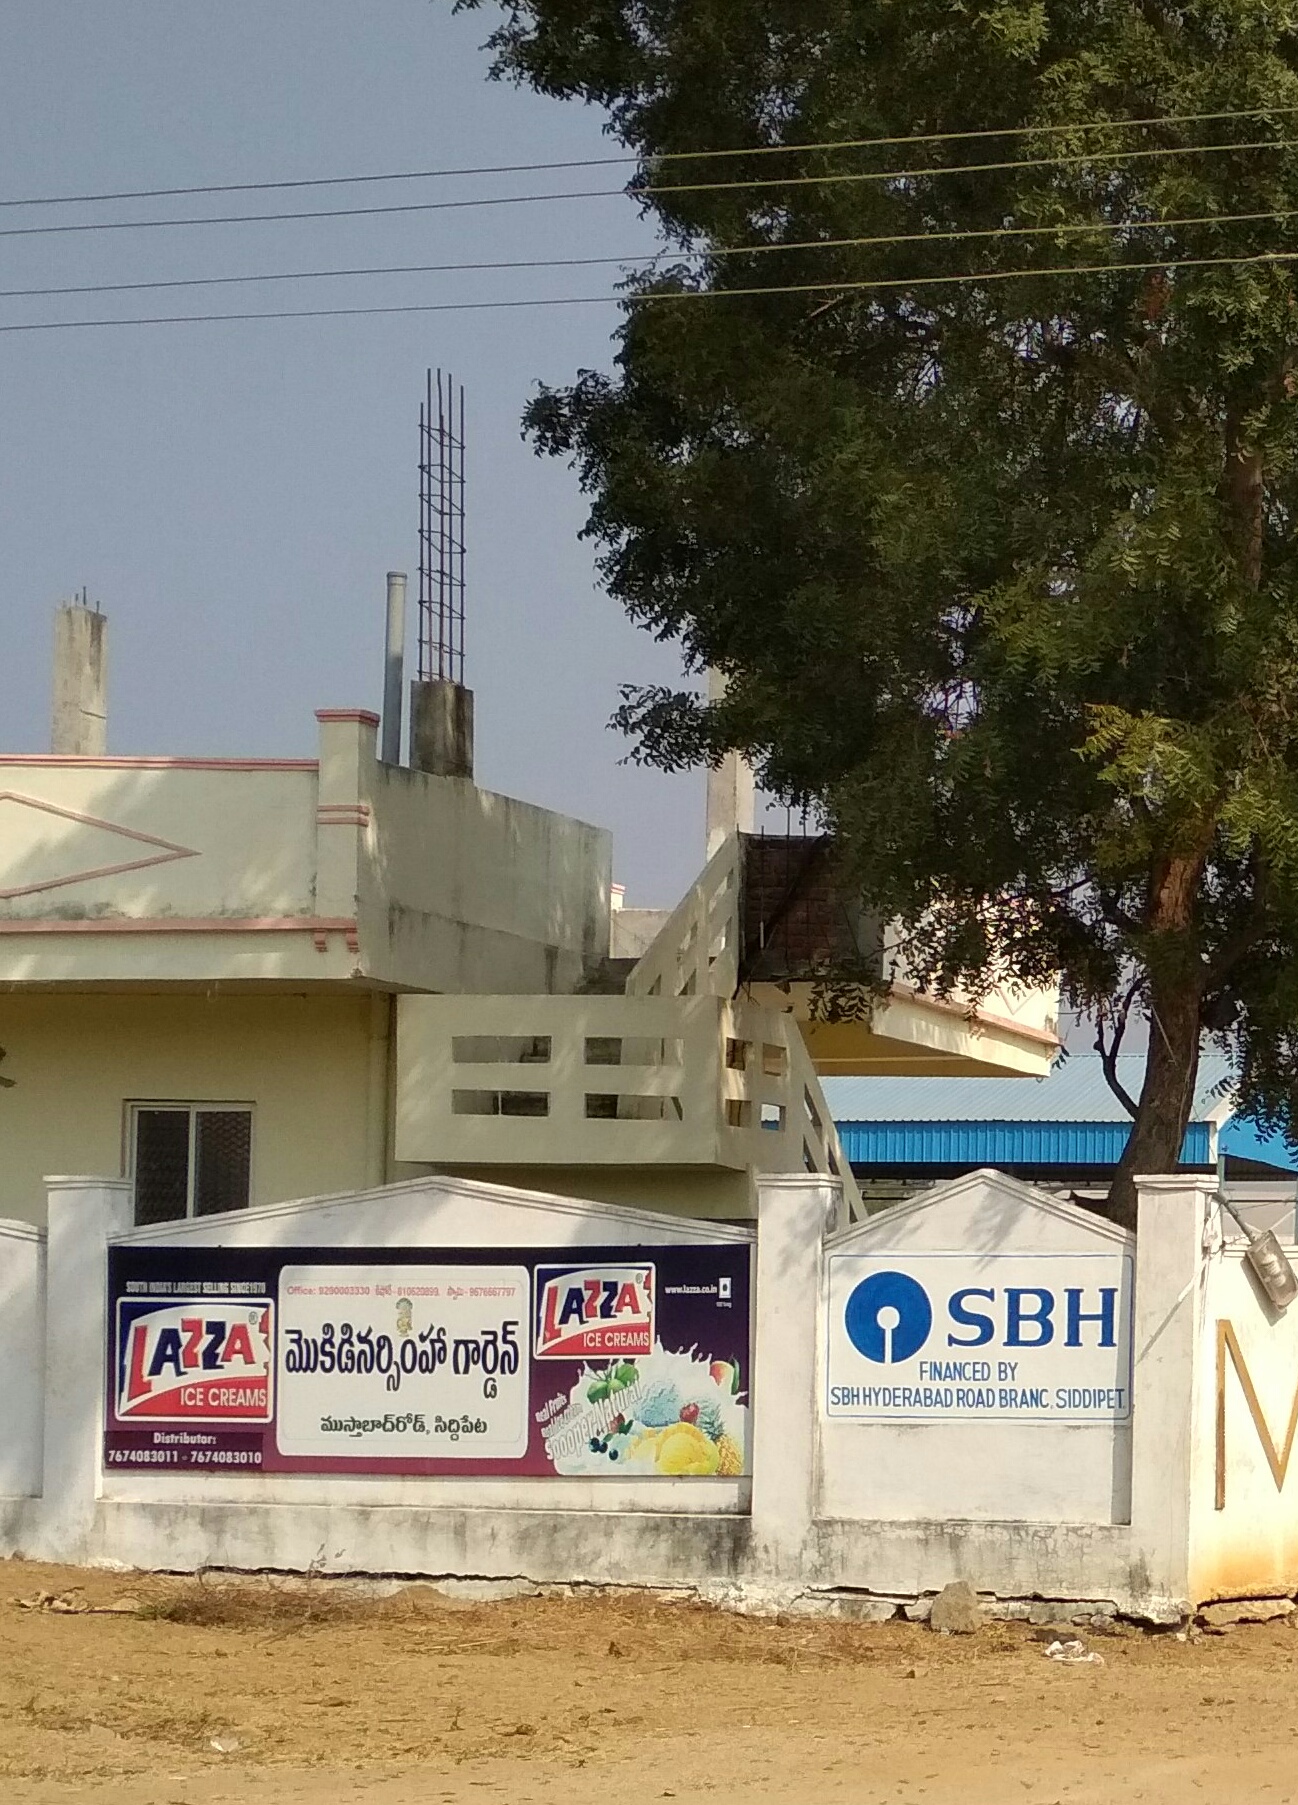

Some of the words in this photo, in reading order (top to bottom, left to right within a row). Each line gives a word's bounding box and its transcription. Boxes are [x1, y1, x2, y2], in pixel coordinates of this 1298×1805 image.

[543, 1278, 642, 1345] LAZZA
[946, 1287, 1119, 1347] SBH
[583, 1331, 601, 1347] ICE
[604, 1331, 650, 1347] CREAMS
[127, 1318, 256, 1402] LAZZA
[919, 1361, 991, 1382] FINANCED
[998, 1362, 1019, 1382] BY
[180, 1387, 203, 1406] ICE
[207, 1388, 266, 1407] CREAMS
[830, 1386, 860, 1406] SBH
[862, 1387, 954, 1408] HYDERABAD
[956, 1387, 996, 1409] ROAD
[153, 1432, 217, 1445] Distributor:
[108, 1450, 178, 1463] 7674083011
[190, 1451, 262, 1464] 7674083010
